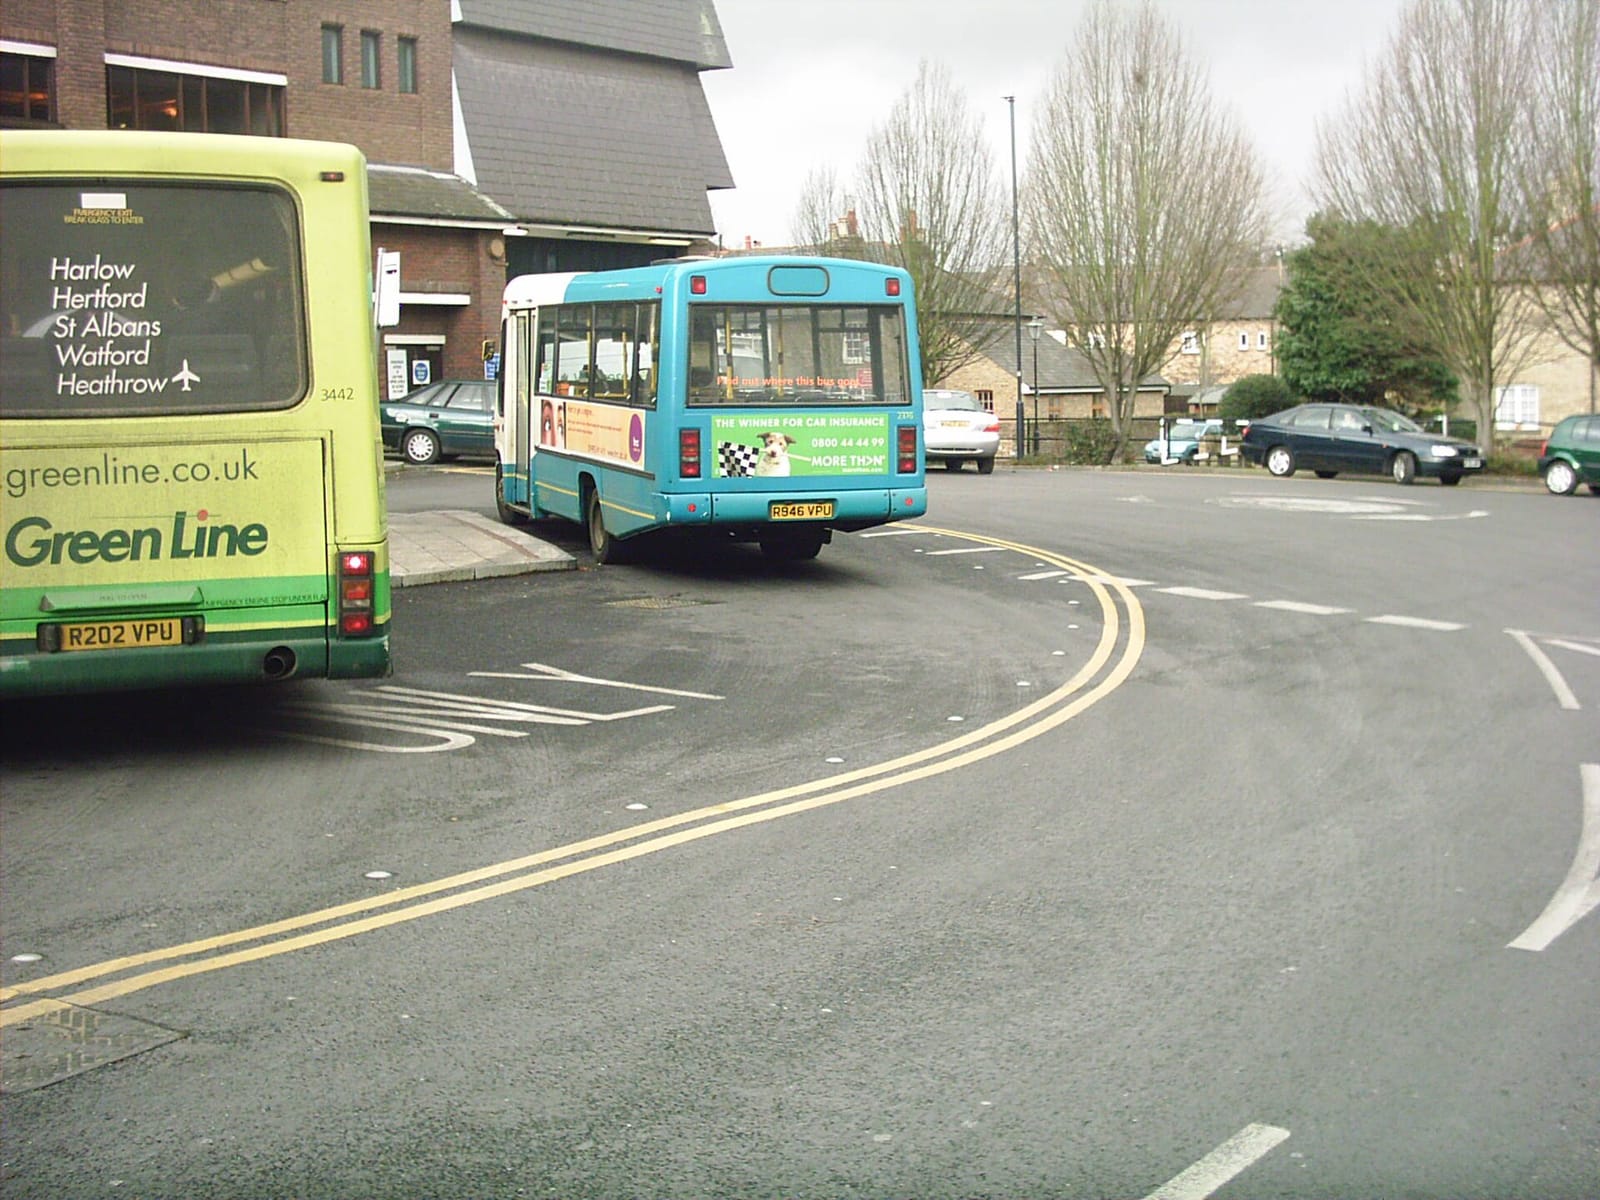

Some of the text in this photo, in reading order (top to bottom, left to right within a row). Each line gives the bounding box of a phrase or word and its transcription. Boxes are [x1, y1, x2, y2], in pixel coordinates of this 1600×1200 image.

[111, 215, 121, 223] TO
[51, 254, 135, 281] Harlow
[52, 283, 147, 310] Hertford
[54, 312, 161, 338] St Albans
[55, 340, 150, 366] Watford
[57, 369, 168, 396] Heathrow
[762, 376, 793, 386] where
[796, 375, 814, 386] this
[817, 375, 835, 386] bus
[321, 387, 354, 401] 3442
[715, 416, 884, 428] THE WINNER FOR CAR INSURANCE
[811, 437, 884, 448] 0800 44 44 99
[811, 455, 846, 467] MORE
[6, 449, 259, 498] greenline.co.uk
[772, 505, 832, 517] R946 VPU
[5, 509, 269, 567] Green Line
[69, 622, 173, 646] R202 VPU
